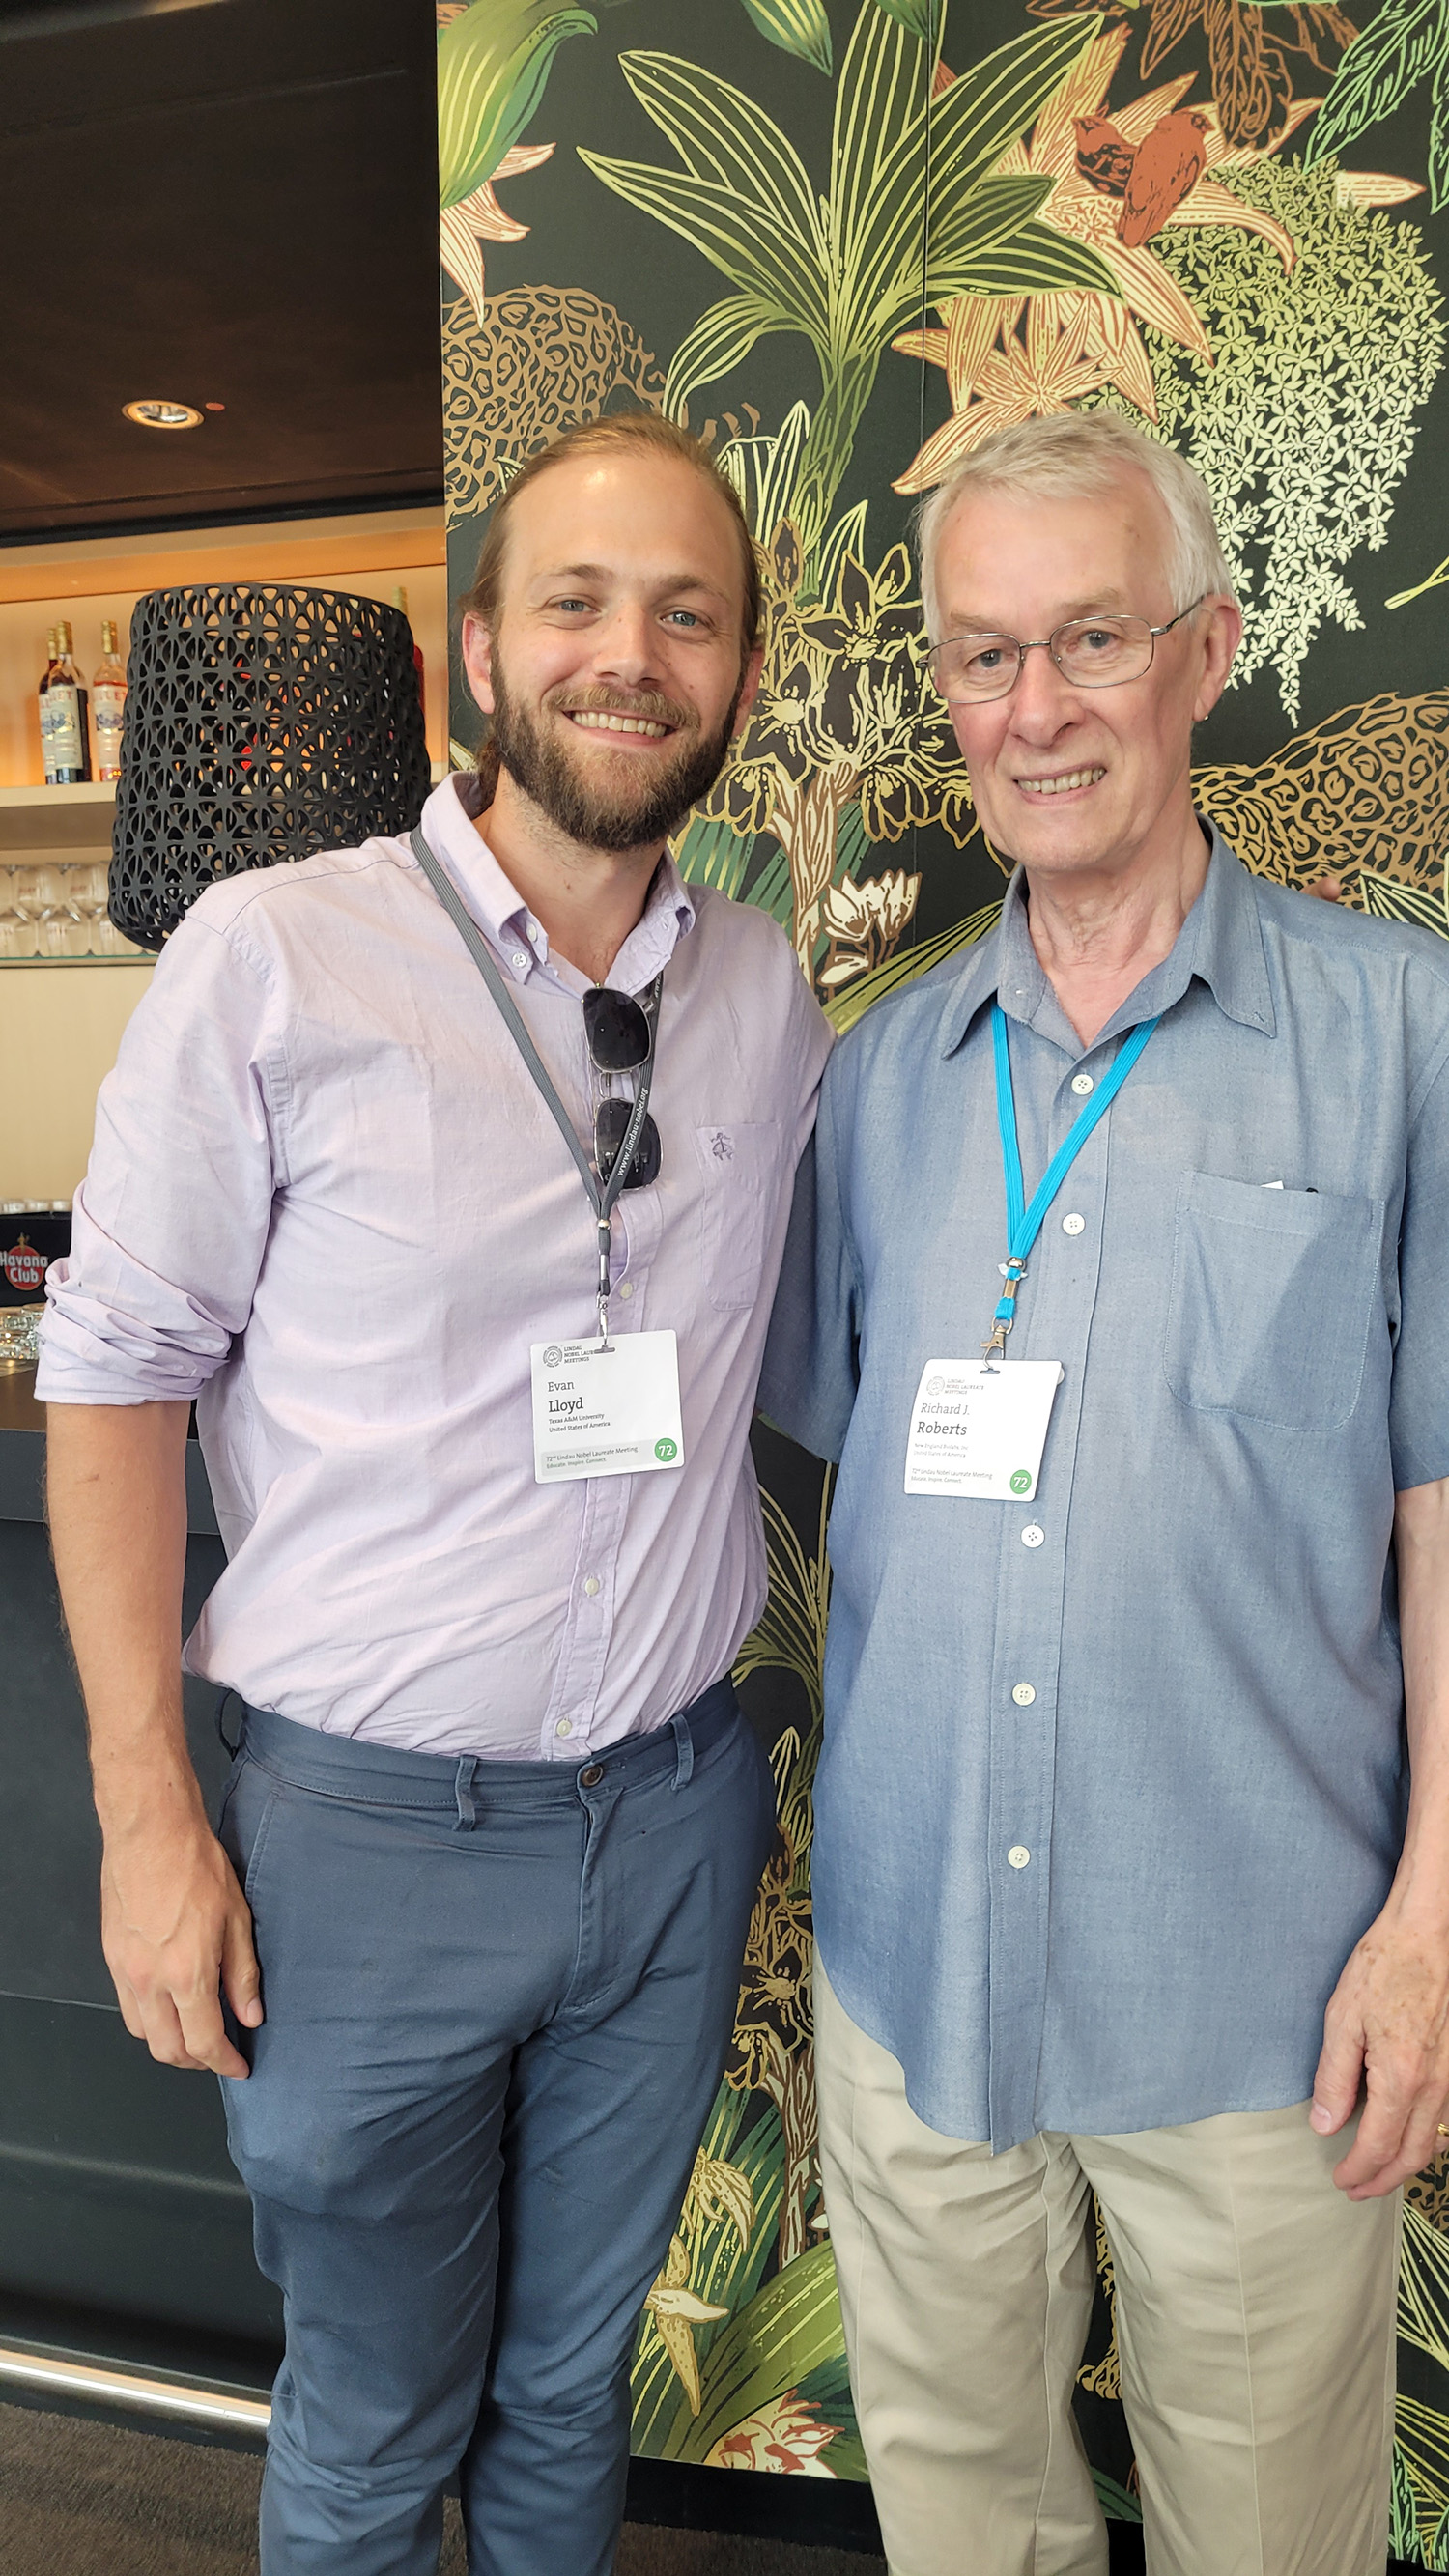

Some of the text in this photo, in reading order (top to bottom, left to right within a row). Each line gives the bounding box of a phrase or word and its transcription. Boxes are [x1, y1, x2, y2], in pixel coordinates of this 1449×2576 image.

[617, 1088, 649, 1176] www.lindau-nobel.org
[0, 1250, 49, 1267] Havana
[10, 1267, 39, 1283] Club
[548, 1381, 575, 1392] Evan
[548, 1397, 584, 1415] Lloyd
[921, 1402, 970, 1416] Richard J.
[917, 1421, 968, 1436] Roberts
[615, 1446, 639, 1455] Meeting
[658, 1444, 674, 1457] 72
[972, 1471, 993, 1481] Meeting
[1013, 1476, 1028, 1488] 72
